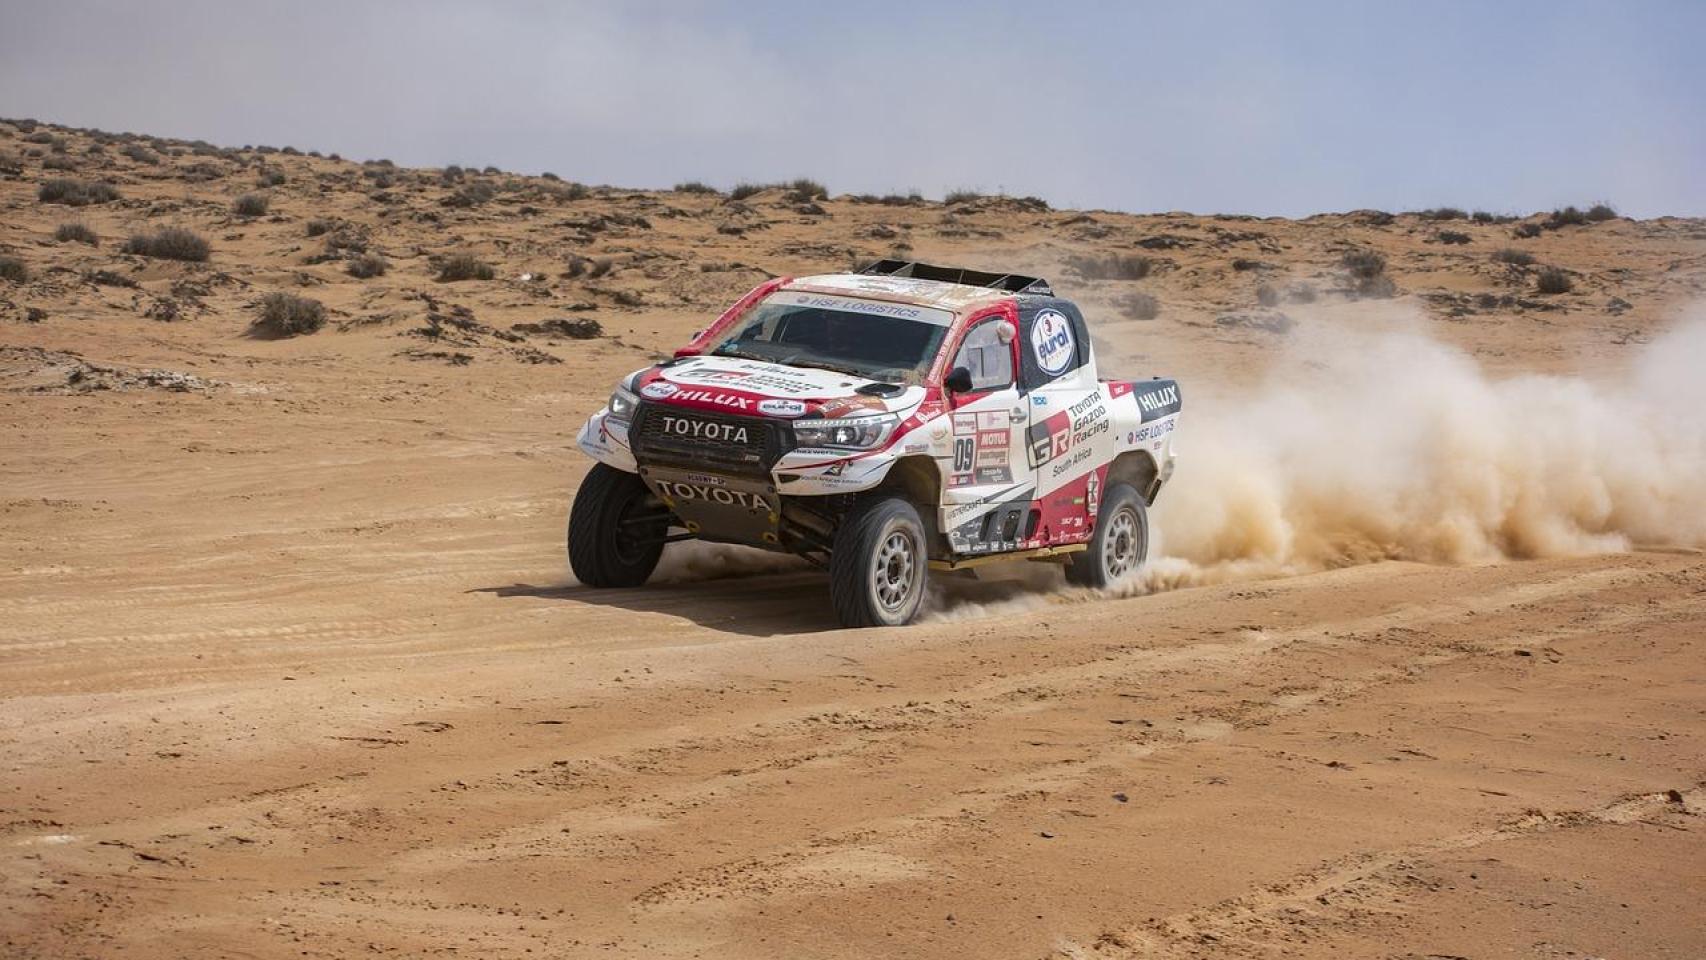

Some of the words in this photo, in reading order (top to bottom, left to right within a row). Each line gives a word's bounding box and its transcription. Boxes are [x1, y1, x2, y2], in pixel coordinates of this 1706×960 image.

[842, 301, 920, 318] LOGISTICS
[1038, 324, 1070, 358] eurol
[672, 389, 755, 410] HILUX
[1068, 391, 1103, 417] TOYOTA
[1138, 384, 1179, 411] HILUX
[663, 416, 748, 443] TOYOTA
[1073, 405, 1107, 432] GAZOO
[980, 431, 1007, 446] MOTUL
[1072, 418, 1110, 447] Racing
[953, 438, 974, 471] 09
[1052, 459, 1072, 478] South
[1072, 447, 1093, 466] Africa
[655, 479, 772, 511] TOYOTA
